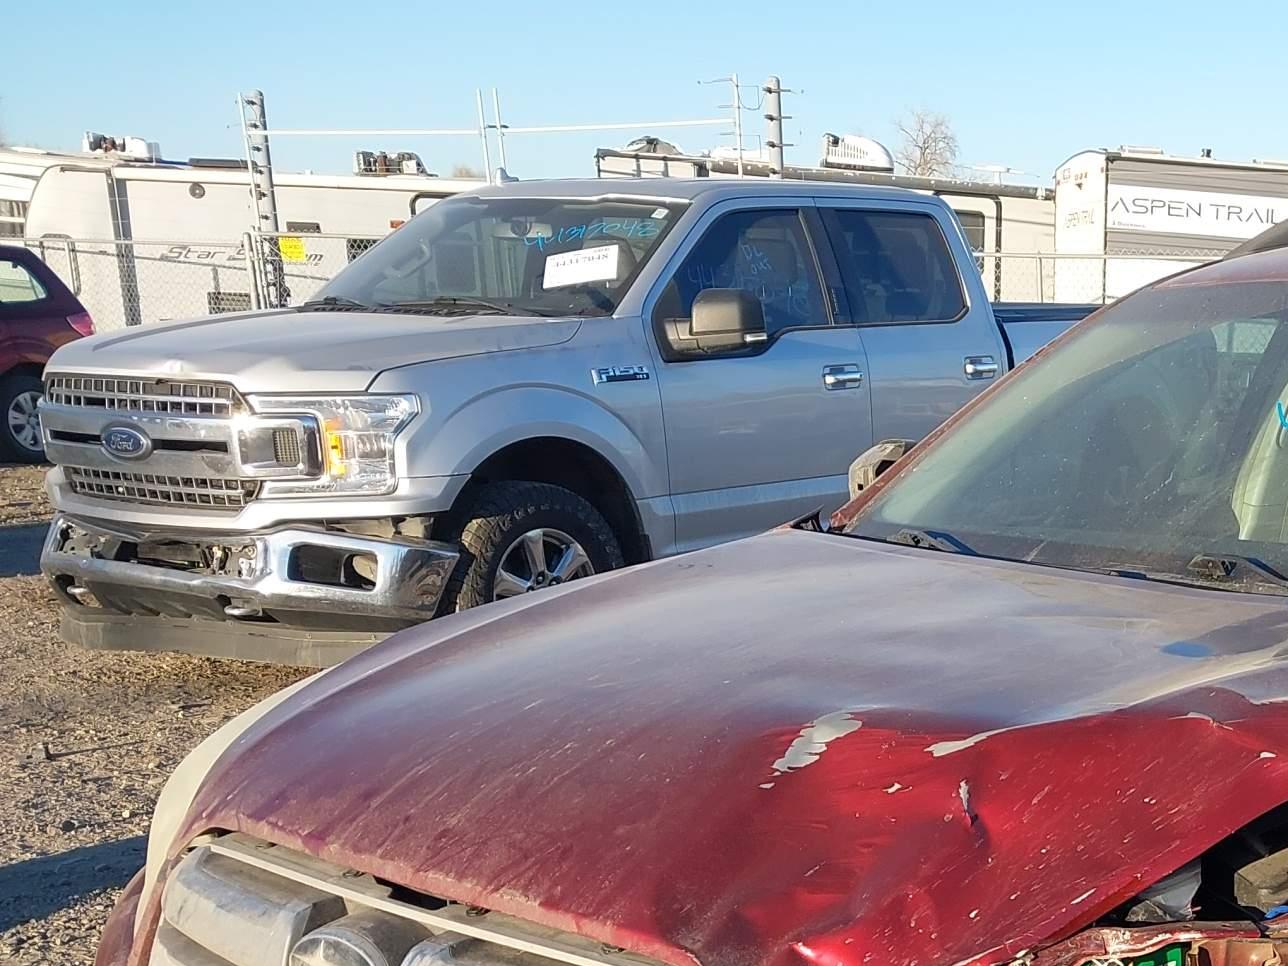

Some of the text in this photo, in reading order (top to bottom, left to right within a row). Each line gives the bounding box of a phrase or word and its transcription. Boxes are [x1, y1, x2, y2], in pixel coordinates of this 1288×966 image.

[1111, 196, 1280, 226] ASPEN TRAIL
[160, 246, 226, 262] Star
